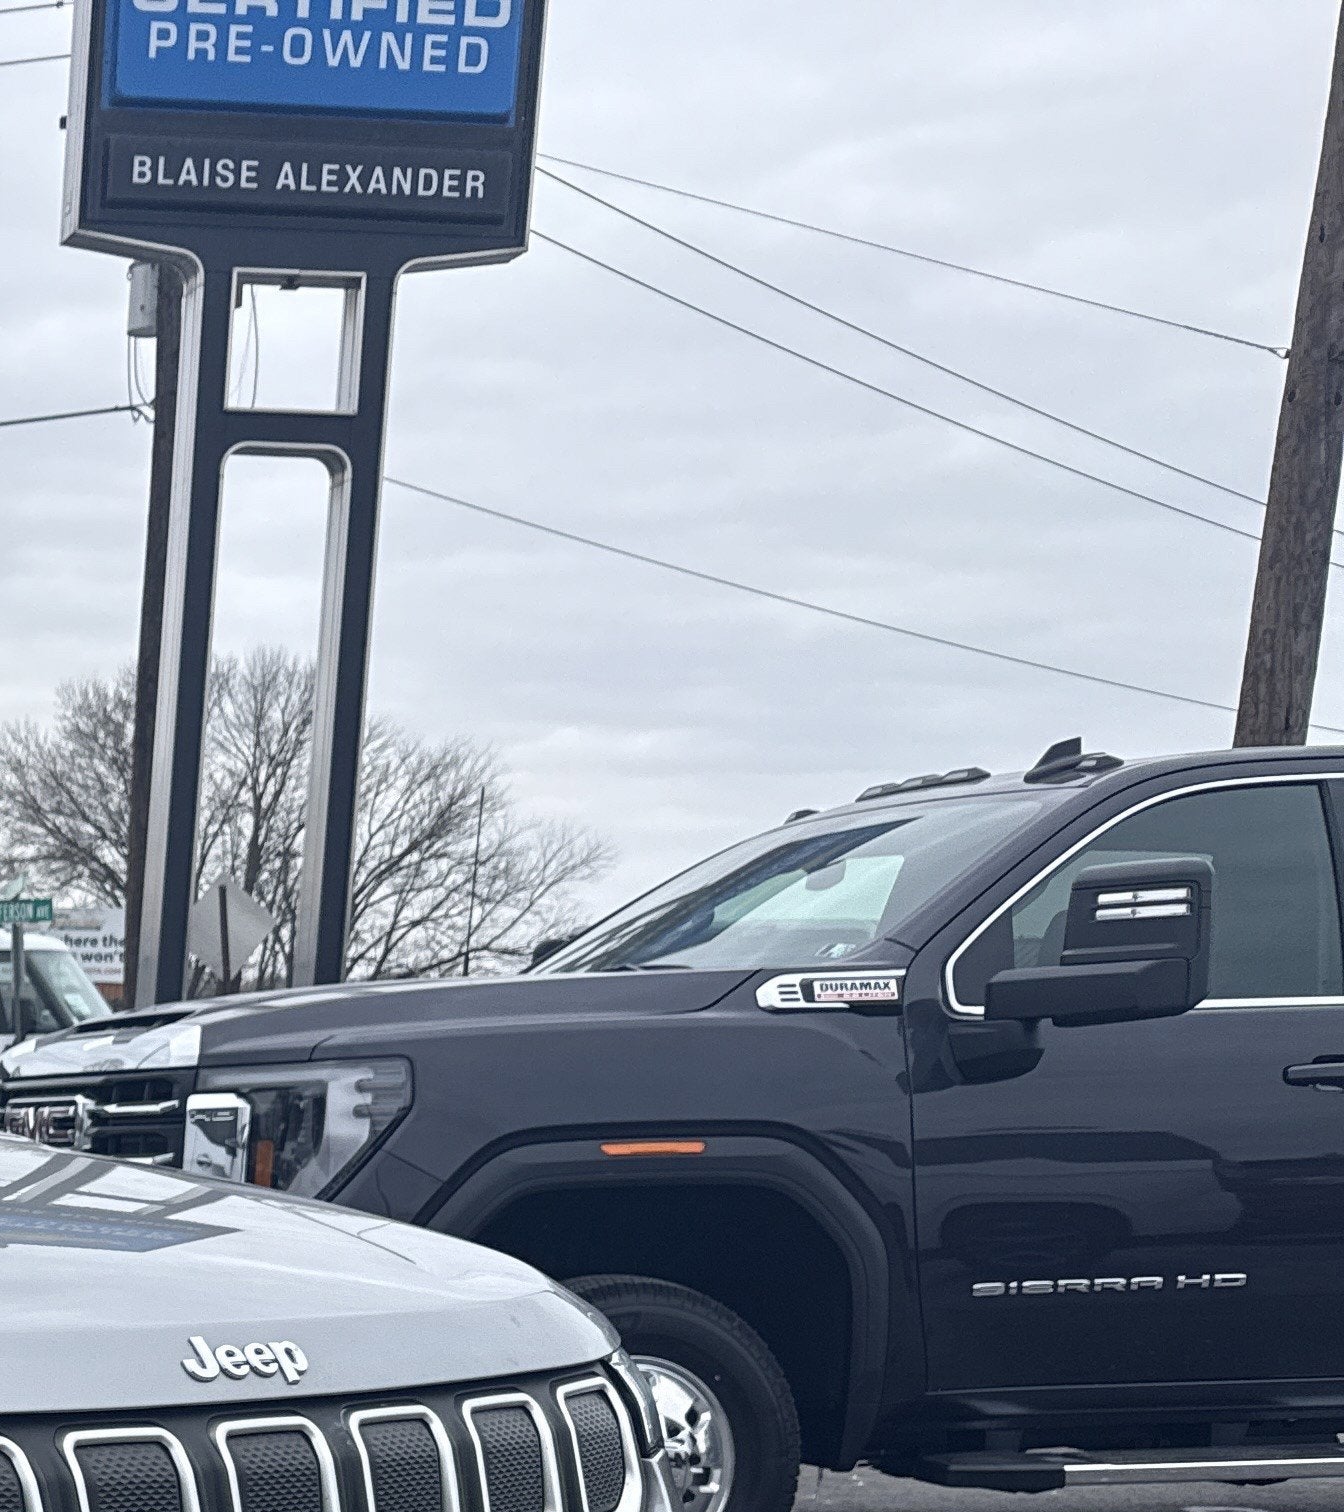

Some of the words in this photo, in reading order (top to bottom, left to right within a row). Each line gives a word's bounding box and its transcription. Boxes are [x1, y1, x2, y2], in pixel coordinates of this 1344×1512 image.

[148, 20, 489, 74] PRE-OWNED
[132, 154, 259, 189] BLAISE
[275, 161, 486, 199] ALEXANDER
[819, 981, 892, 993] DURAMAX
[1175, 1272, 1248, 1291] HD
[180, 1335, 309, 1386] Jeep
